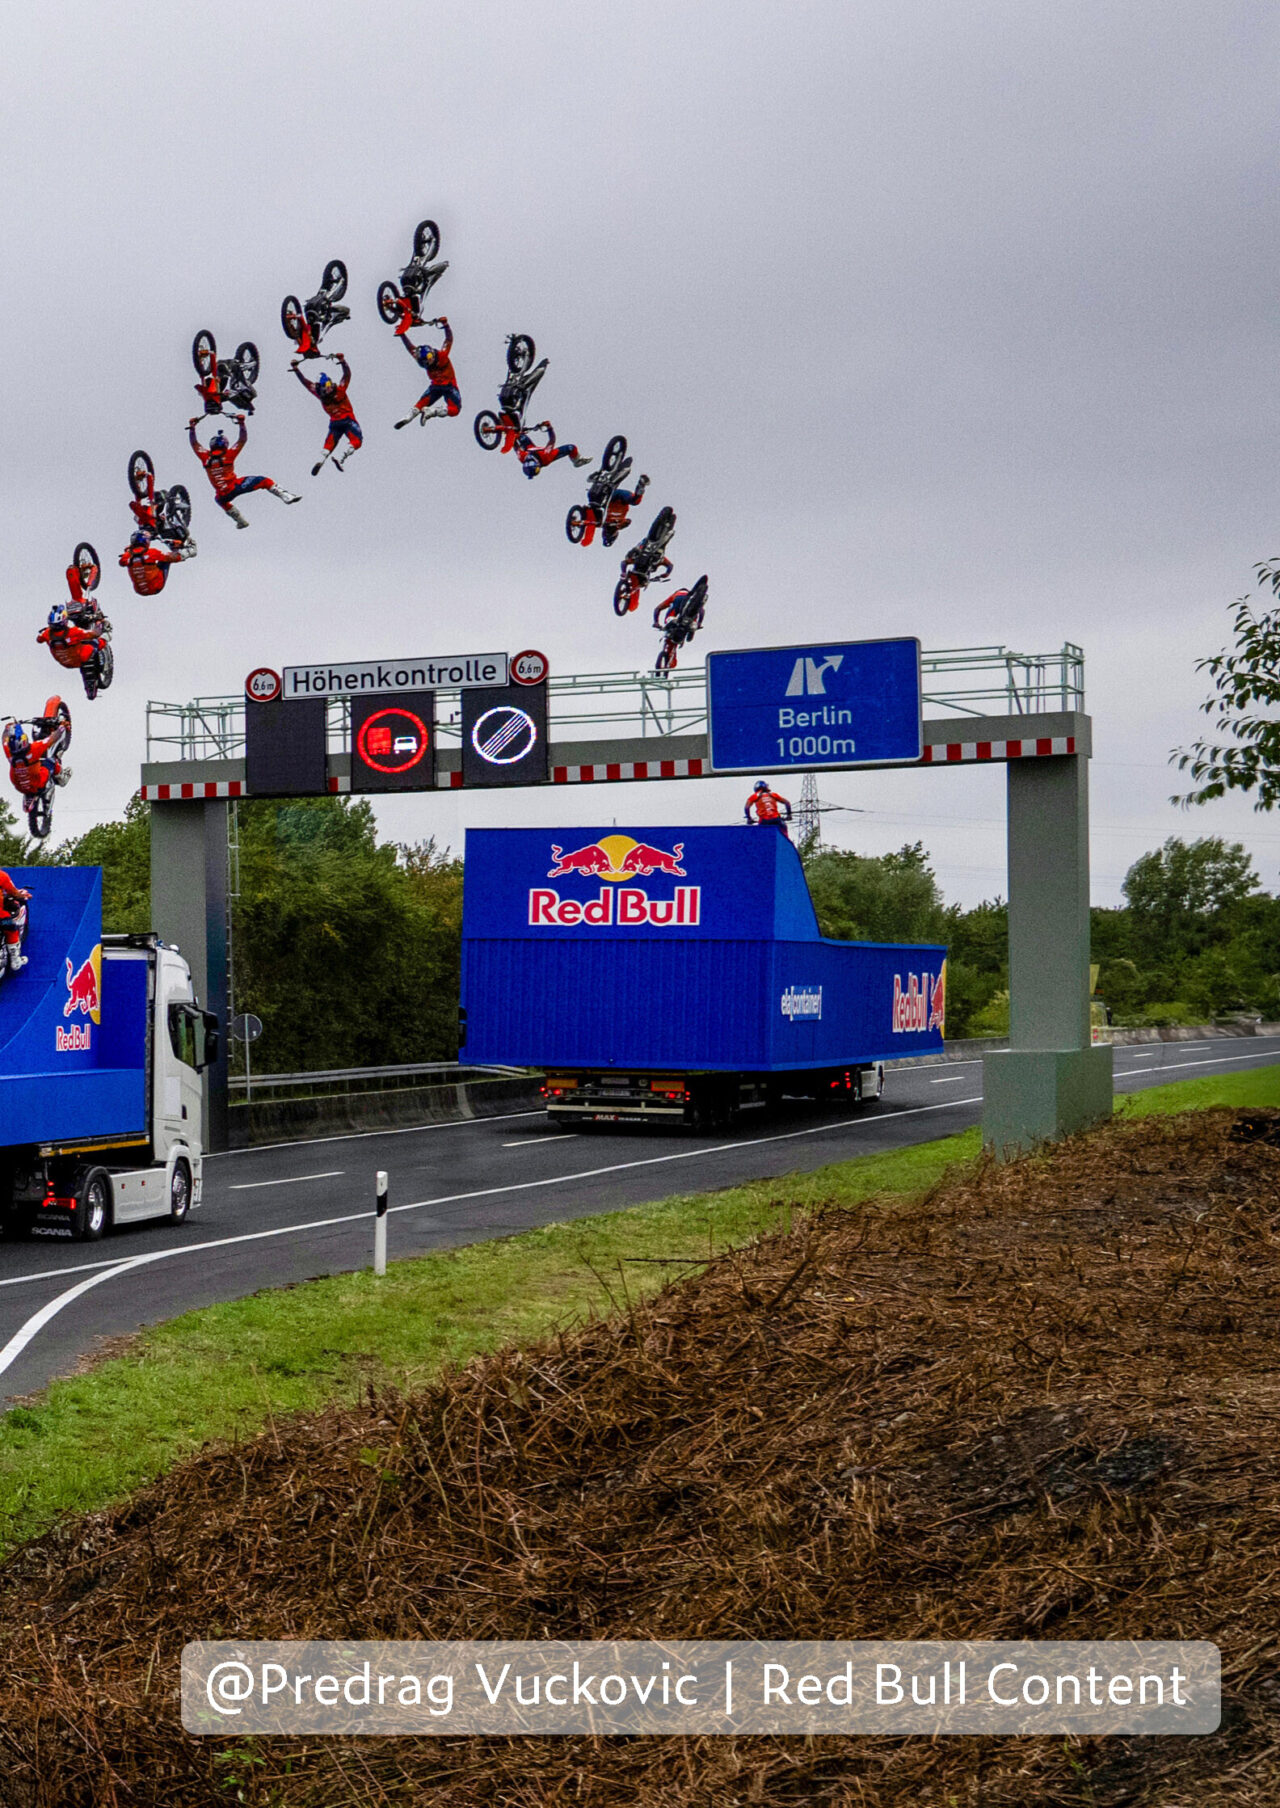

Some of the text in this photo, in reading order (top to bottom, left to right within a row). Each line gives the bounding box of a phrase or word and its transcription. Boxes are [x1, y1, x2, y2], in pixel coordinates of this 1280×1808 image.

[292, 660, 497, 694] Höhenkontrolle
[778, 705, 853, 729] Berlin
[776, 735, 856, 758] 1000m
[528, 886, 701, 927] Red Bull
[31, 1226, 73, 1237] SCANIA
